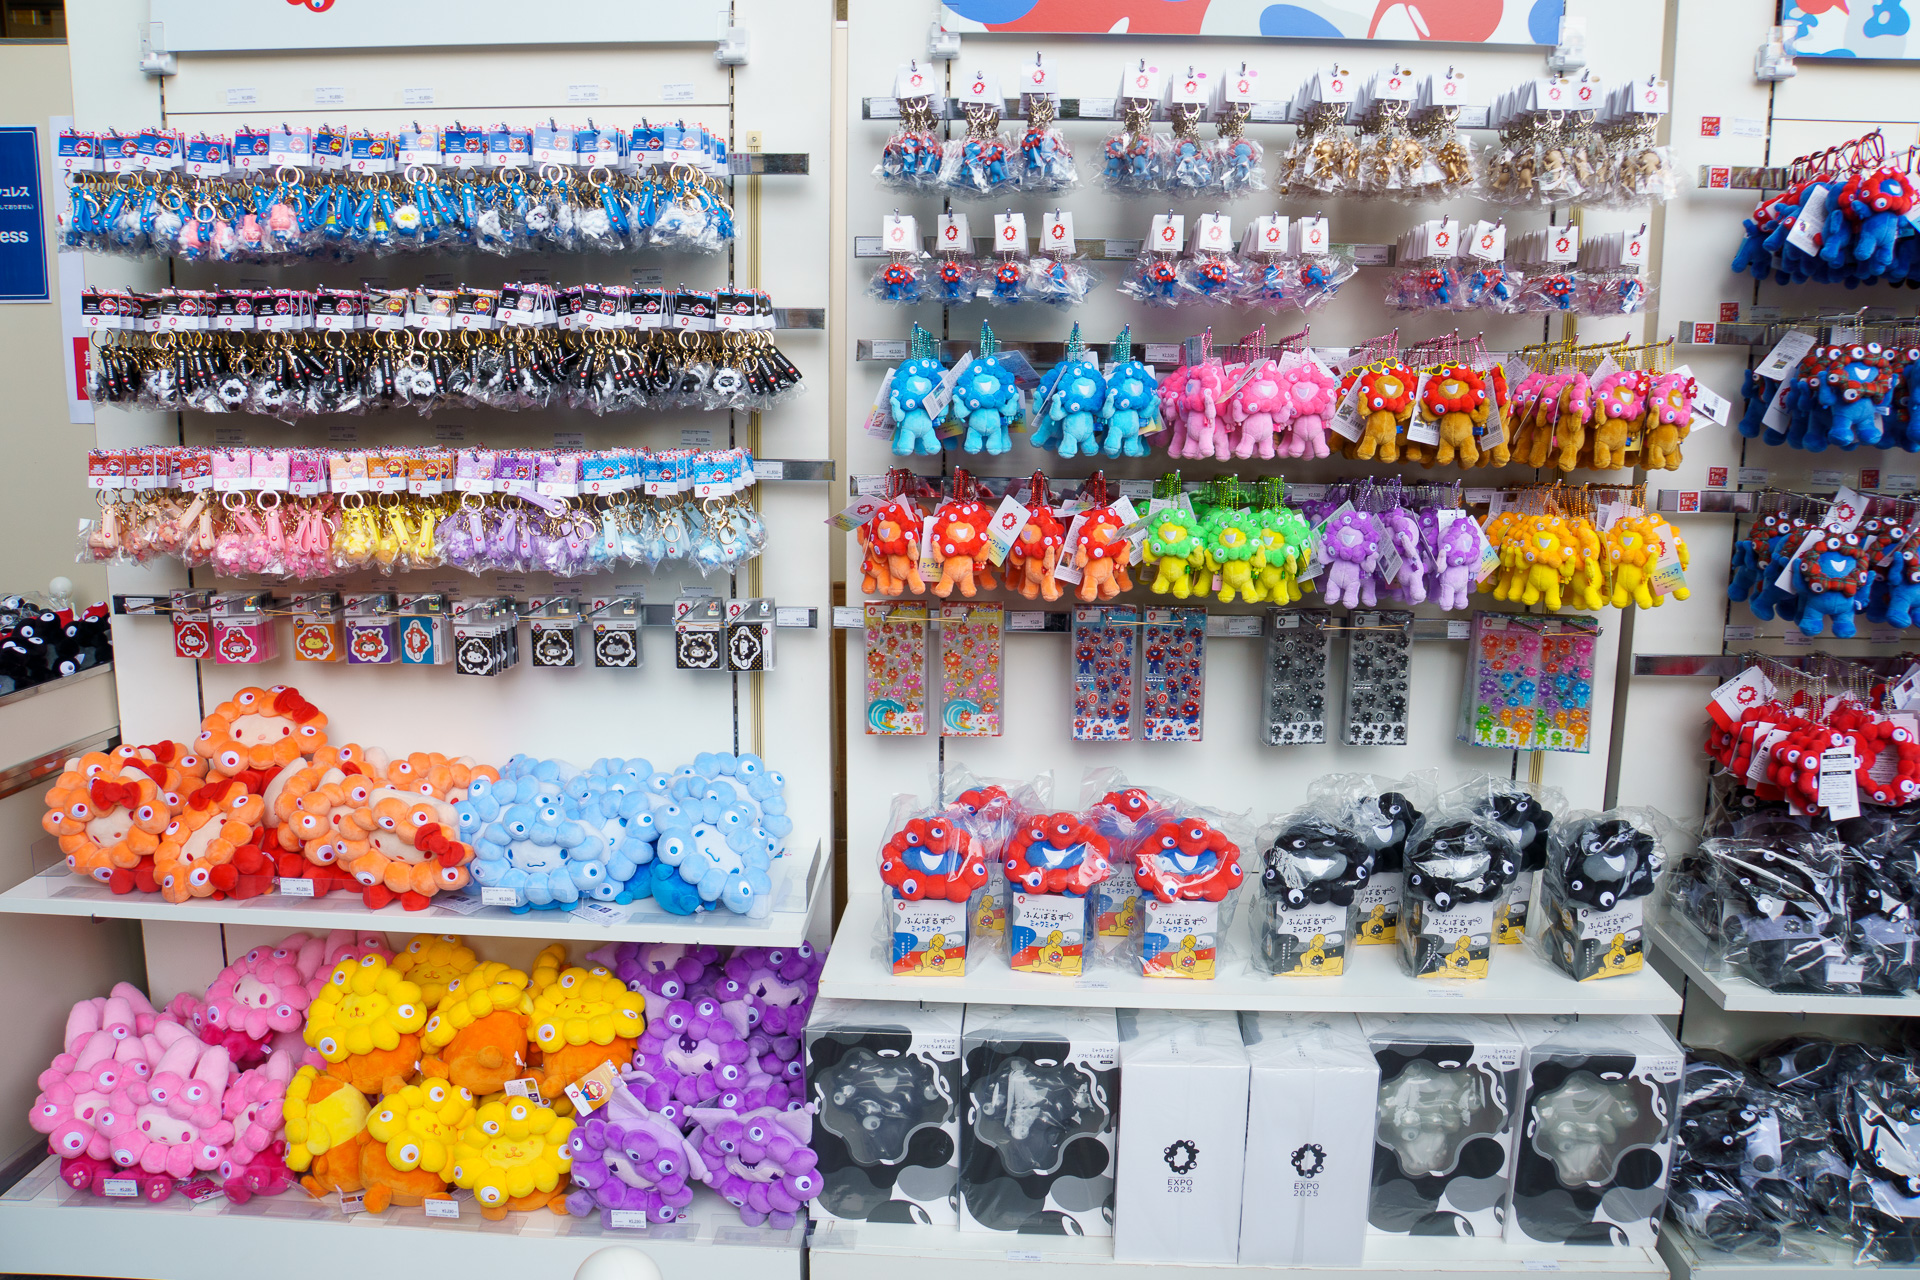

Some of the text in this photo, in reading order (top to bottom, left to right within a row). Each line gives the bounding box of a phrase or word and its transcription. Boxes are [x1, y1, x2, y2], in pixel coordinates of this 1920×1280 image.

[0, 187, 30, 197] ュレス
[1653, 567, 1680, 582] ミャクミャク
[911, 925, 942, 933] ミャクミャク
[1030, 920, 1060, 929] ミャクミャク
[1594, 926, 1622, 937] ミャクミャク
[1293, 1182, 1320, 1190] EXPO
